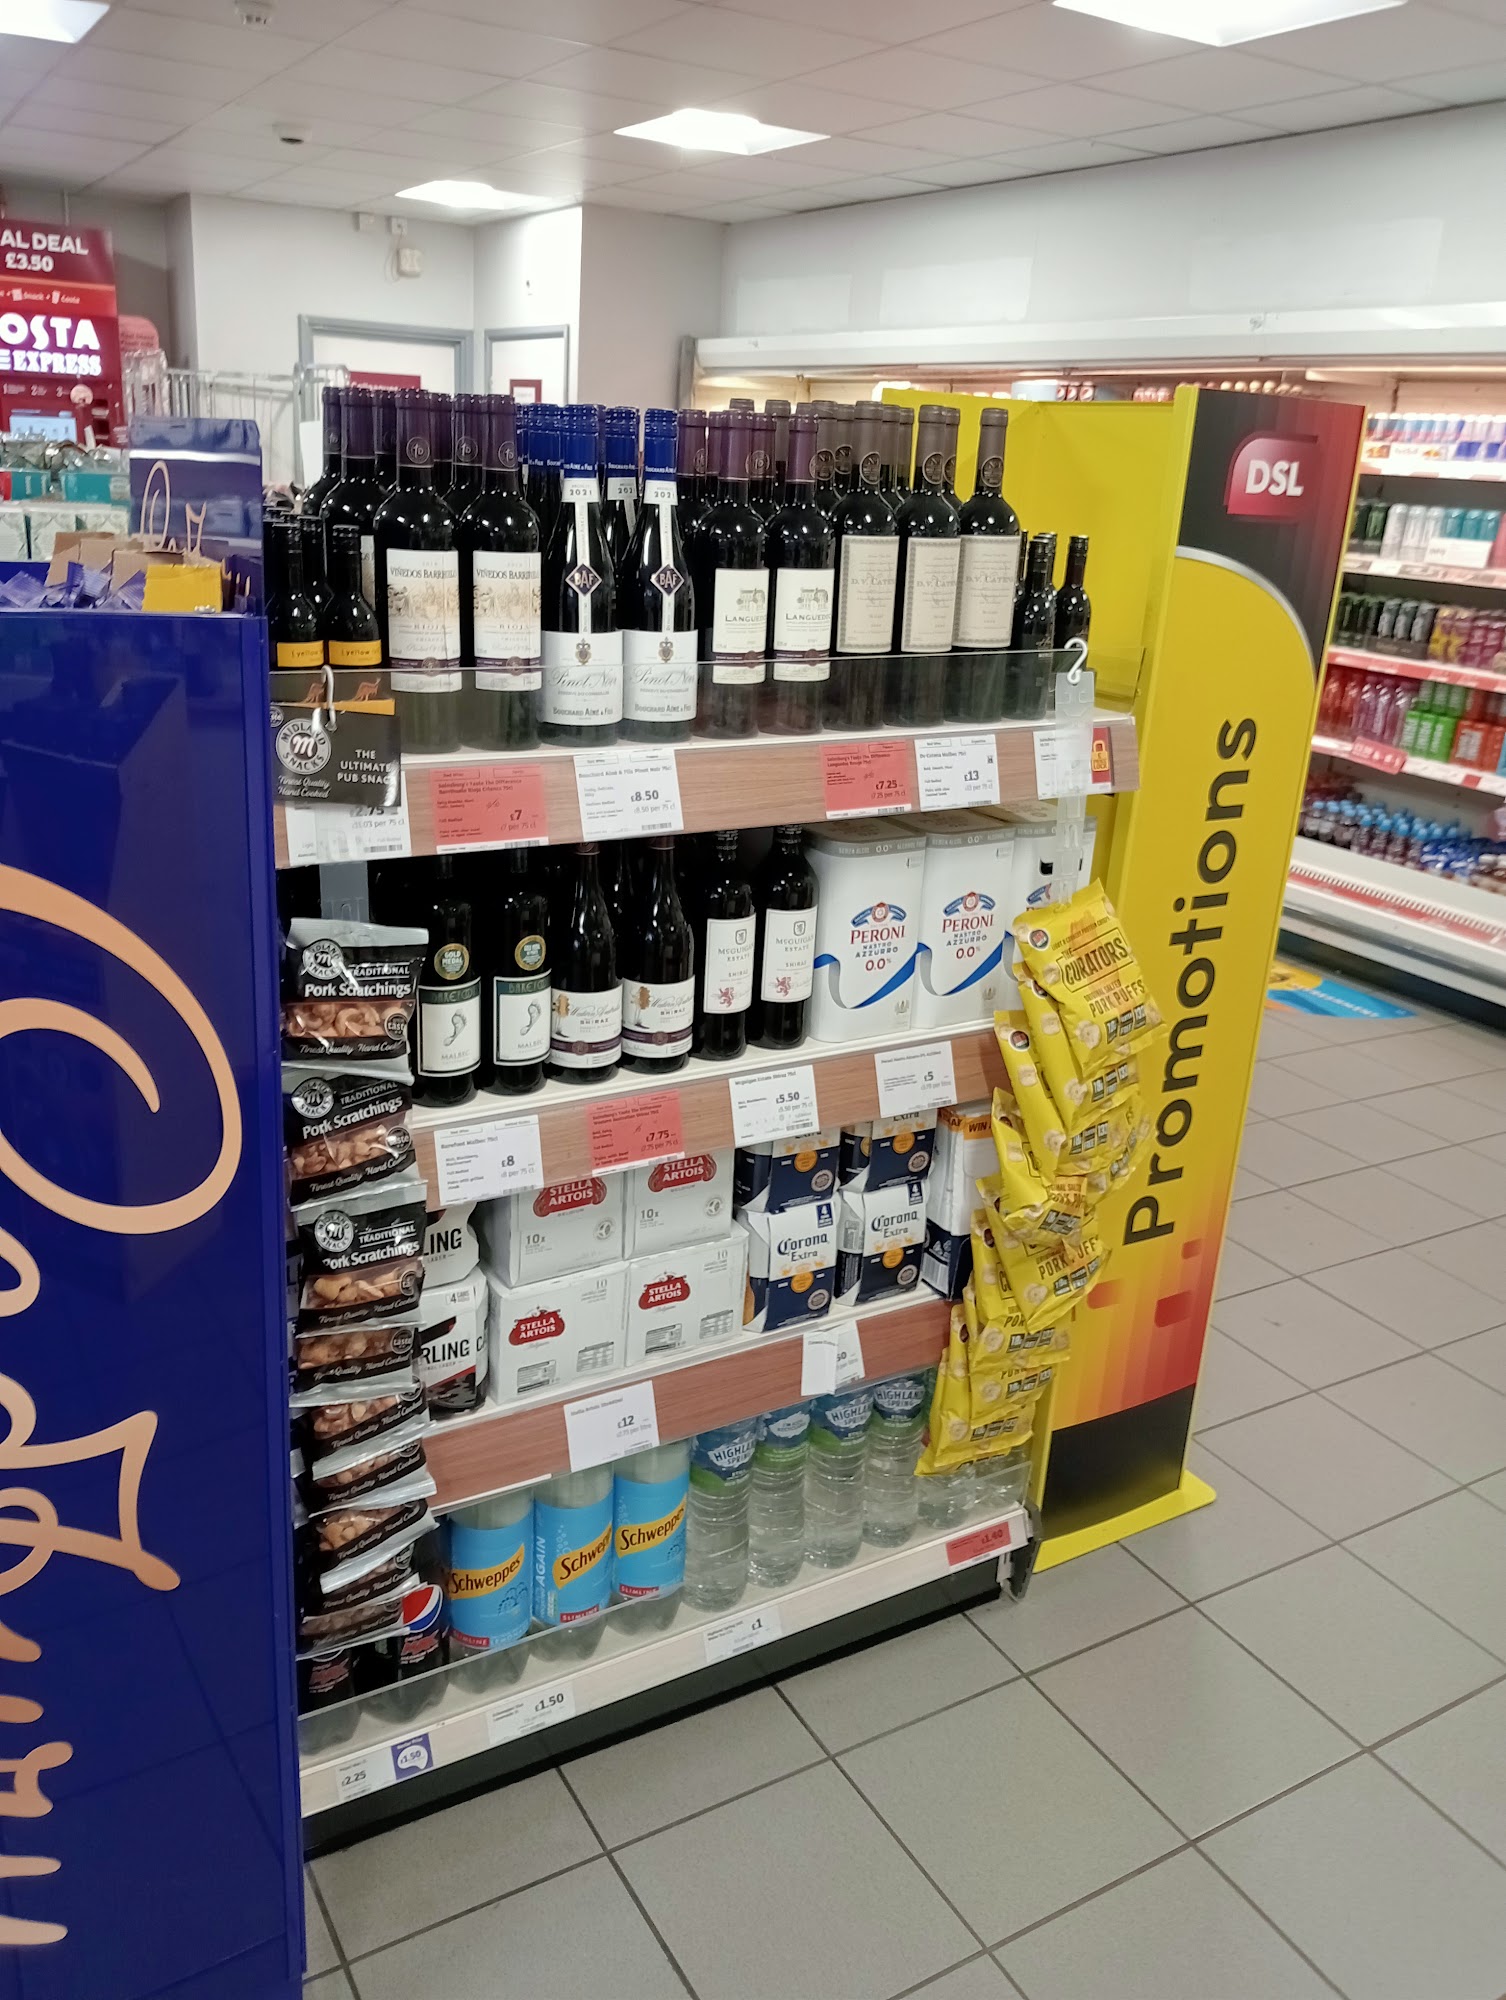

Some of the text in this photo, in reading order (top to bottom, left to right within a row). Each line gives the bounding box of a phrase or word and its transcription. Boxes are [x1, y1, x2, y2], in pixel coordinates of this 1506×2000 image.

[32, 232, 89, 255] DEAL
[5, 252, 54, 272] £3.50
[12, 349, 102, 377] EXPRESS
[1245, 459, 1304, 497] DSL
[658, 571, 678, 588] BAF
[552, 667, 591, 687] Pinot
[632, 665, 673, 684] Pinot
[355, 750, 376, 760] THE
[283, 752, 325, 775] SNACKS
[278, 775, 330, 789] Finest Quality
[337, 773, 391, 785] PUB SNAC
[964, 770, 979, 781] £13
[277, 786, 332, 798] Hand Cooked
[876, 780, 897, 790] £7.25
[631, 790, 659, 802] £8.50
[510, 809, 522, 821] £7
[650, 805, 661, 813] per
[508, 823, 519, 831] per
[942, 914, 994, 934] PERONI
[850, 925, 906, 945] PERONI
[946, 934, 988, 947] AZZURRO
[954, 930, 982, 939] NASTRO
[855, 947, 899, 958] AZZURRO
[862, 941, 892, 950] NASTRO
[1062, 948, 1073, 960] THE
[1064, 937, 1129, 986] CURATORS
[305, 981, 411, 998] Pork Scratchings
[1104, 979, 1122, 993] SALTED
[1122, 717, 1258, 1247] Promotions
[1089, 979, 1146, 1018] PORK PUFFS
[924, 1071, 934, 1082] £5
[340, 1082, 398, 1105] TRADITIONAL
[776, 1092, 800, 1104] £5.50
[302, 1096, 403, 1139] Pork Scratchings
[968, 1121, 986, 1133] WIN
[646, 1130, 669, 1142] £7.75
[501, 1155, 515, 1167] £8
[663, 1156, 704, 1173] STELLA
[309, 1181, 335, 1192] Finest
[365, 1163, 388, 1176] Hand
[508, 1170, 519, 1178] per
[662, 1166, 704, 1184] ARTOIS
[549, 1179, 594, 1198] STELLA
[911, 1184, 918, 1194] 4
[548, 1190, 594, 1208] ARTOIS
[820, 1204, 827, 1214] 4
[871, 1209, 919, 1234] Corona
[359, 1225, 416, 1244] TRADITIONAL
[883, 1226, 909, 1240] Extra
[777, 1231, 829, 1257] Corona
[322, 1241, 420, 1269] Pork Scratchings
[716, 1249, 728, 1260] 10
[790, 1249, 818, 1263] Extra
[1038, 1254, 1069, 1281] PORK
[595, 1279, 608, 1290] 10
[648, 1282, 682, 1297] STELLA
[450, 1293, 457, 1304] 4
[647, 1290, 682, 1305] ARTOIS
[520, 1316, 556, 1332] STELLA
[519, 1325, 556, 1340] ARTOIS
[617, 1415, 634, 1428] £12
[536, 1536, 546, 1586] AGAIN
[451, 1553, 522, 1596] Schweppes
[562, 1607, 598, 1622] SLIMLINE
[752, 1618, 762, 1630] £1
[535, 1693, 564, 1712] £1.50
[401, 1750, 421, 1764] £1.50
[341, 1770, 366, 1786] £2.25
